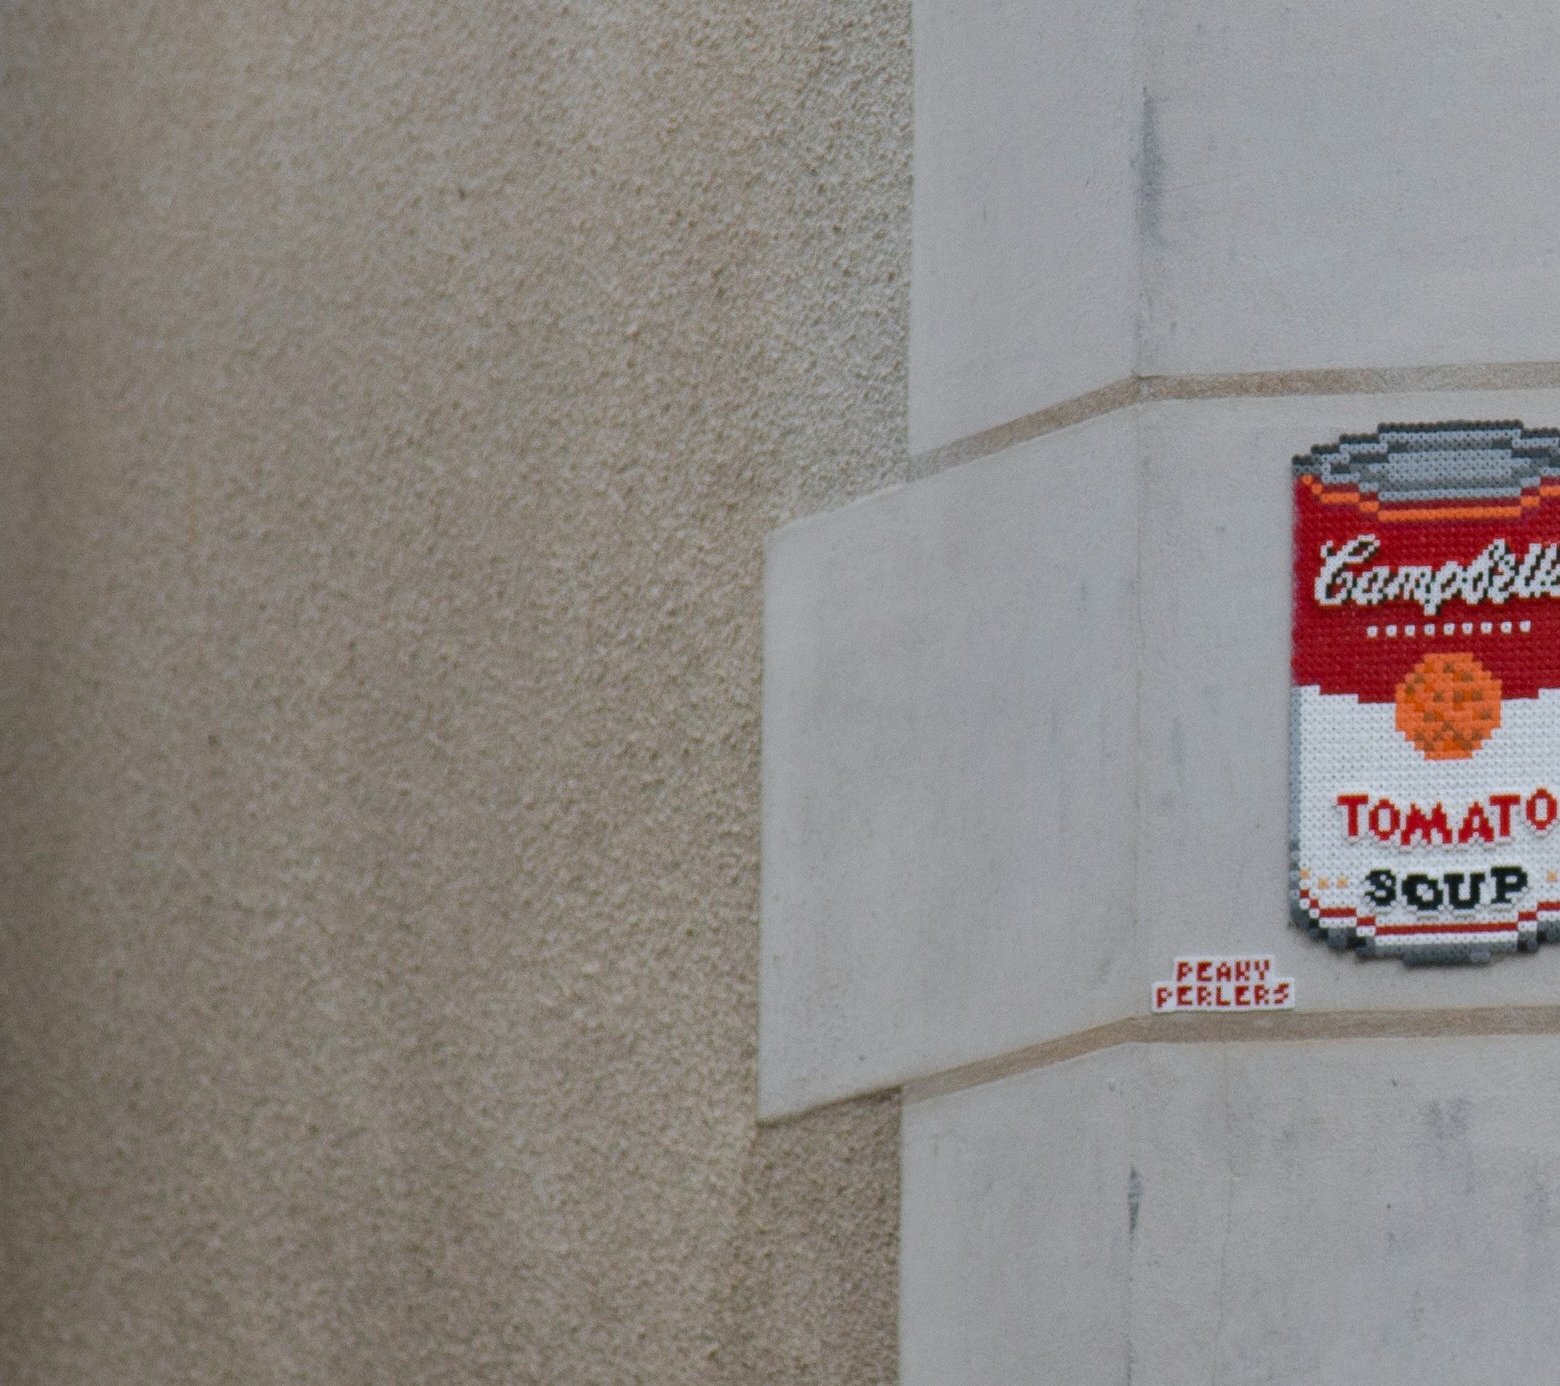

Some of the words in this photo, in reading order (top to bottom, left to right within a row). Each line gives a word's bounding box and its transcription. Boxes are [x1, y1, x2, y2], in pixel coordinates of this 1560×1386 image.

[1336, 787, 1559, 847] TOMATO
[1363, 865, 1529, 911] SOUP
[1176, 959, 1270, 982] PEAKY
[1155, 982, 1289, 1008] PERLERS
